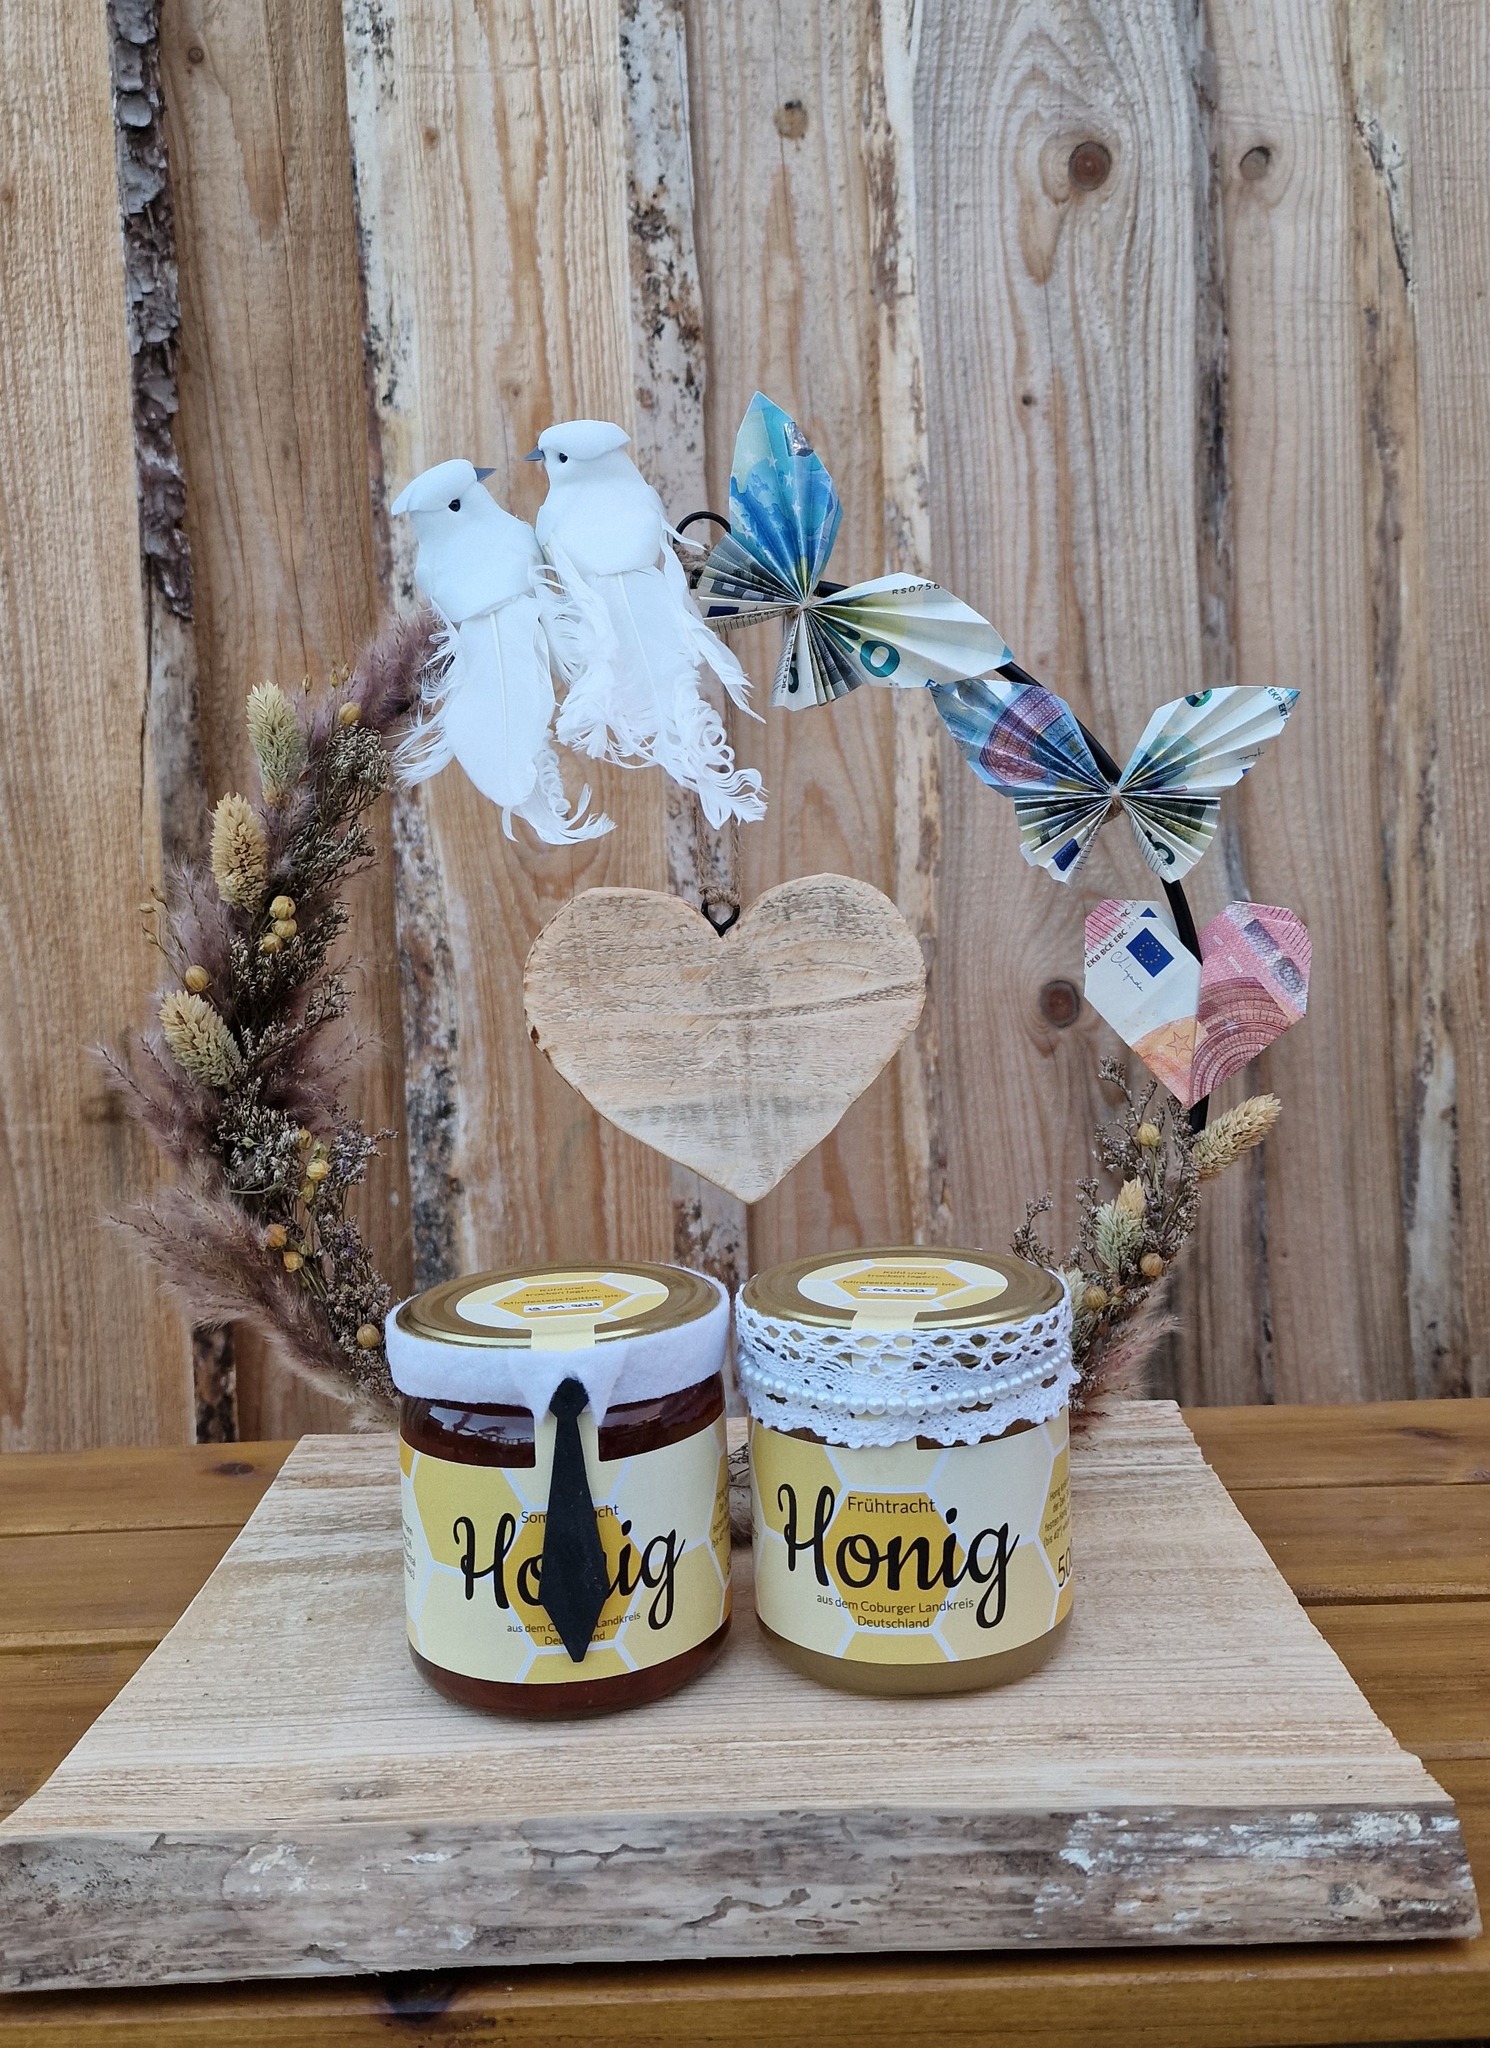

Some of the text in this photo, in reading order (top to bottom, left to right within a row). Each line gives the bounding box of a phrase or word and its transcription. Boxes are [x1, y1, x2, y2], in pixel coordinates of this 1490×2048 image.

[1267, 688, 1283, 702] EKP
[1278, 702, 1288, 717] EKT
[1086, 954, 1101, 968] EKB
[1100, 941, 1115, 956] BCE
[1113, 929, 1128, 943] EBC
[848, 1496, 936, 1514] Frühtracht
[777, 1482, 1020, 1629] Honig
[453, 1512, 686, 1630] Hoig
[816, 1594, 974, 1616] aus dem Coburger Landkreis
[506, 1624, 523, 1633] aus
[525, 1623, 546, 1633] dem
[857, 1615, 930, 1629] Deutschland
